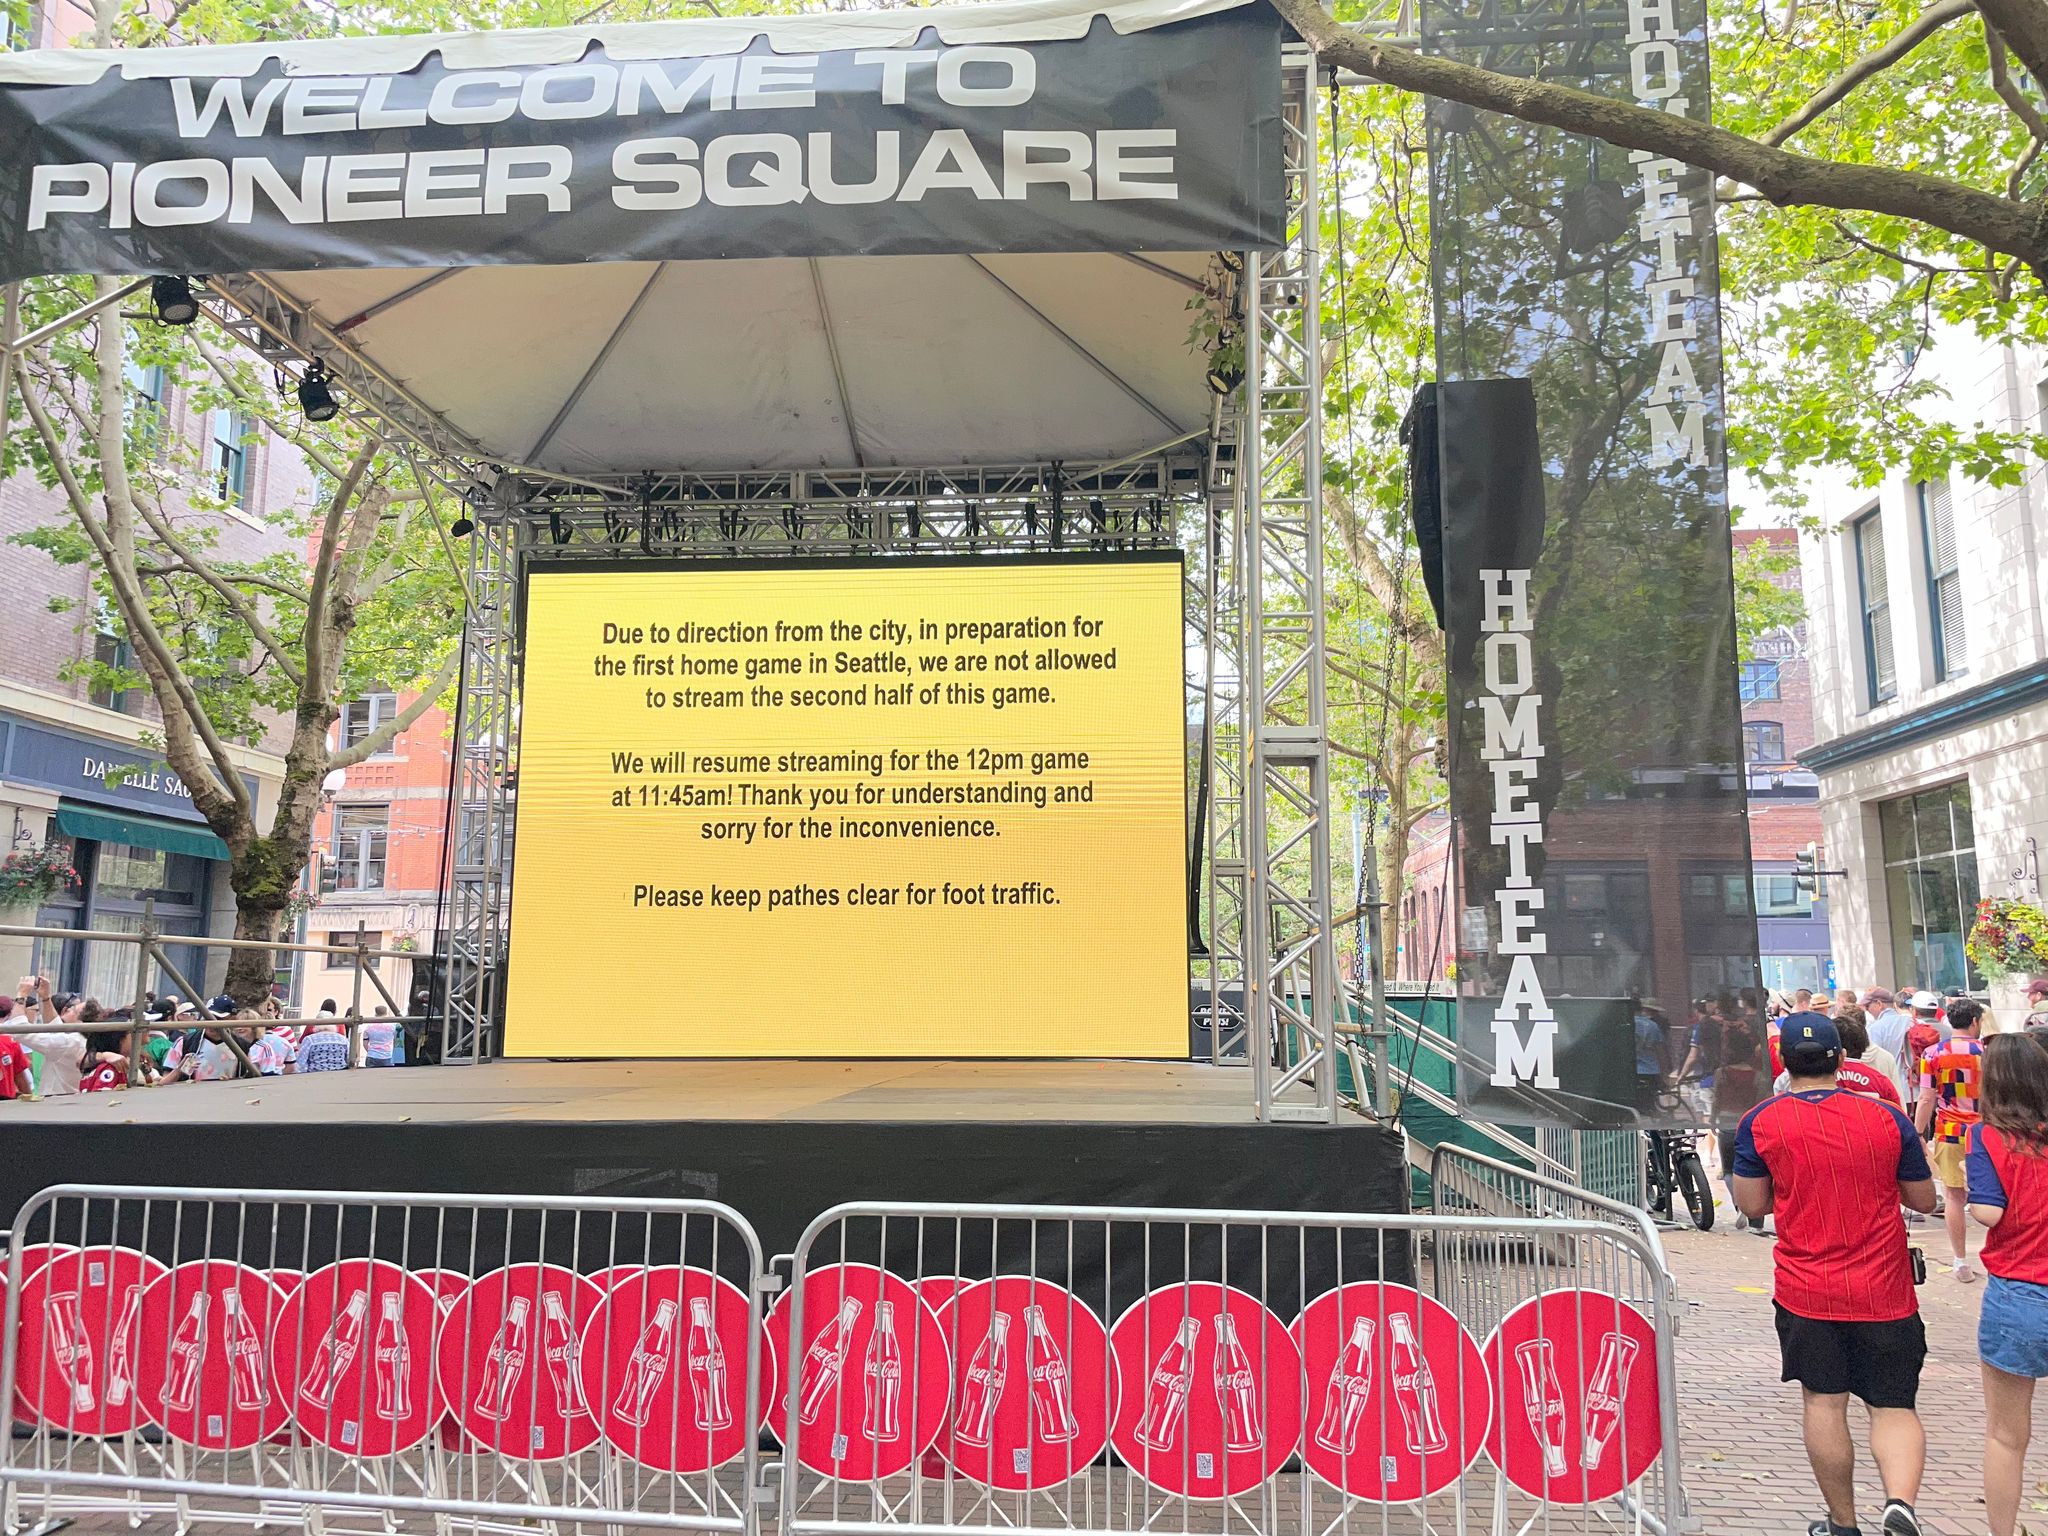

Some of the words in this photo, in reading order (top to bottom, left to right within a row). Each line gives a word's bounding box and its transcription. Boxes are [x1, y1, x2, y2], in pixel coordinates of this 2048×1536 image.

[170, 55, 816, 138] WELCOME
[854, 46, 1036, 107] TO
[27, 144, 573, 231] PIONEER
[611, 129, 1179, 211] SQUARE
[603, 622, 644, 644] Due
[649, 622, 670, 644] to
[676, 621, 768, 644] direction
[774, 620, 824, 642] from
[829, 619, 863, 642] the
[869, 618, 912, 646] city,
[919, 618, 938, 640] in
[945, 616, 1066, 646] preparation
[1072, 615, 1104, 638] for
[594, 654, 626, 677] the
[632, 654, 674, 676] first
[680, 653, 739, 676] home
[745, 657, 802, 681] game
[809, 652, 828, 674] in
[834, 650, 912, 677] Seattle,
[918, 655, 948, 672] we
[954, 654, 988, 672] are
[994, 649, 1029, 671] not
[1034, 647, 1117, 671] allowed
[645, 687, 666, 708] to
[672, 686, 744, 708] stream
[750, 685, 784, 707] the
[790, 683, 867, 707] second
[874, 682, 914, 706] half
[919, 682, 941, 705] of
[946, 682, 985, 705] this
[992, 686, 1056, 710] game.
[83, 757, 159, 791] DAELLE
[611, 751, 644, 774] We
[650, 751, 685, 774] will
[692, 755, 771, 773] resume
[777, 749, 883, 777] streaming
[889, 748, 920, 771] for
[925, 748, 959, 771] the
[966, 748, 1024, 776] 12pm
[1030, 752, 1089, 776] game
[611, 785, 632, 807] at
[638, 783, 733, 807] 11:45am!
[737, 783, 803, 806] Thank
[809, 788, 848, 811] you
[854, 782, 886, 805] for
[892, 780, 1047, 809] understanding
[1053, 780, 1093, 803] and
[700, 822, 757, 845] sorry
[762, 816, 794, 839] for
[798, 816, 832, 839] the
[839, 814, 1001, 838] inconvenience.
[633, 884, 704, 907] Please
[711, 884, 761, 912] keep
[768, 883, 840, 912] pathes
[847, 882, 900, 906] clear
[905, 882, 937, 906] for
[942, 882, 985, 905] foot
[991, 881, 1061, 905] traffic.
[1423, 983, 1435, 991] Ned
[1836, 1070, 1870, 1086] AINOO
